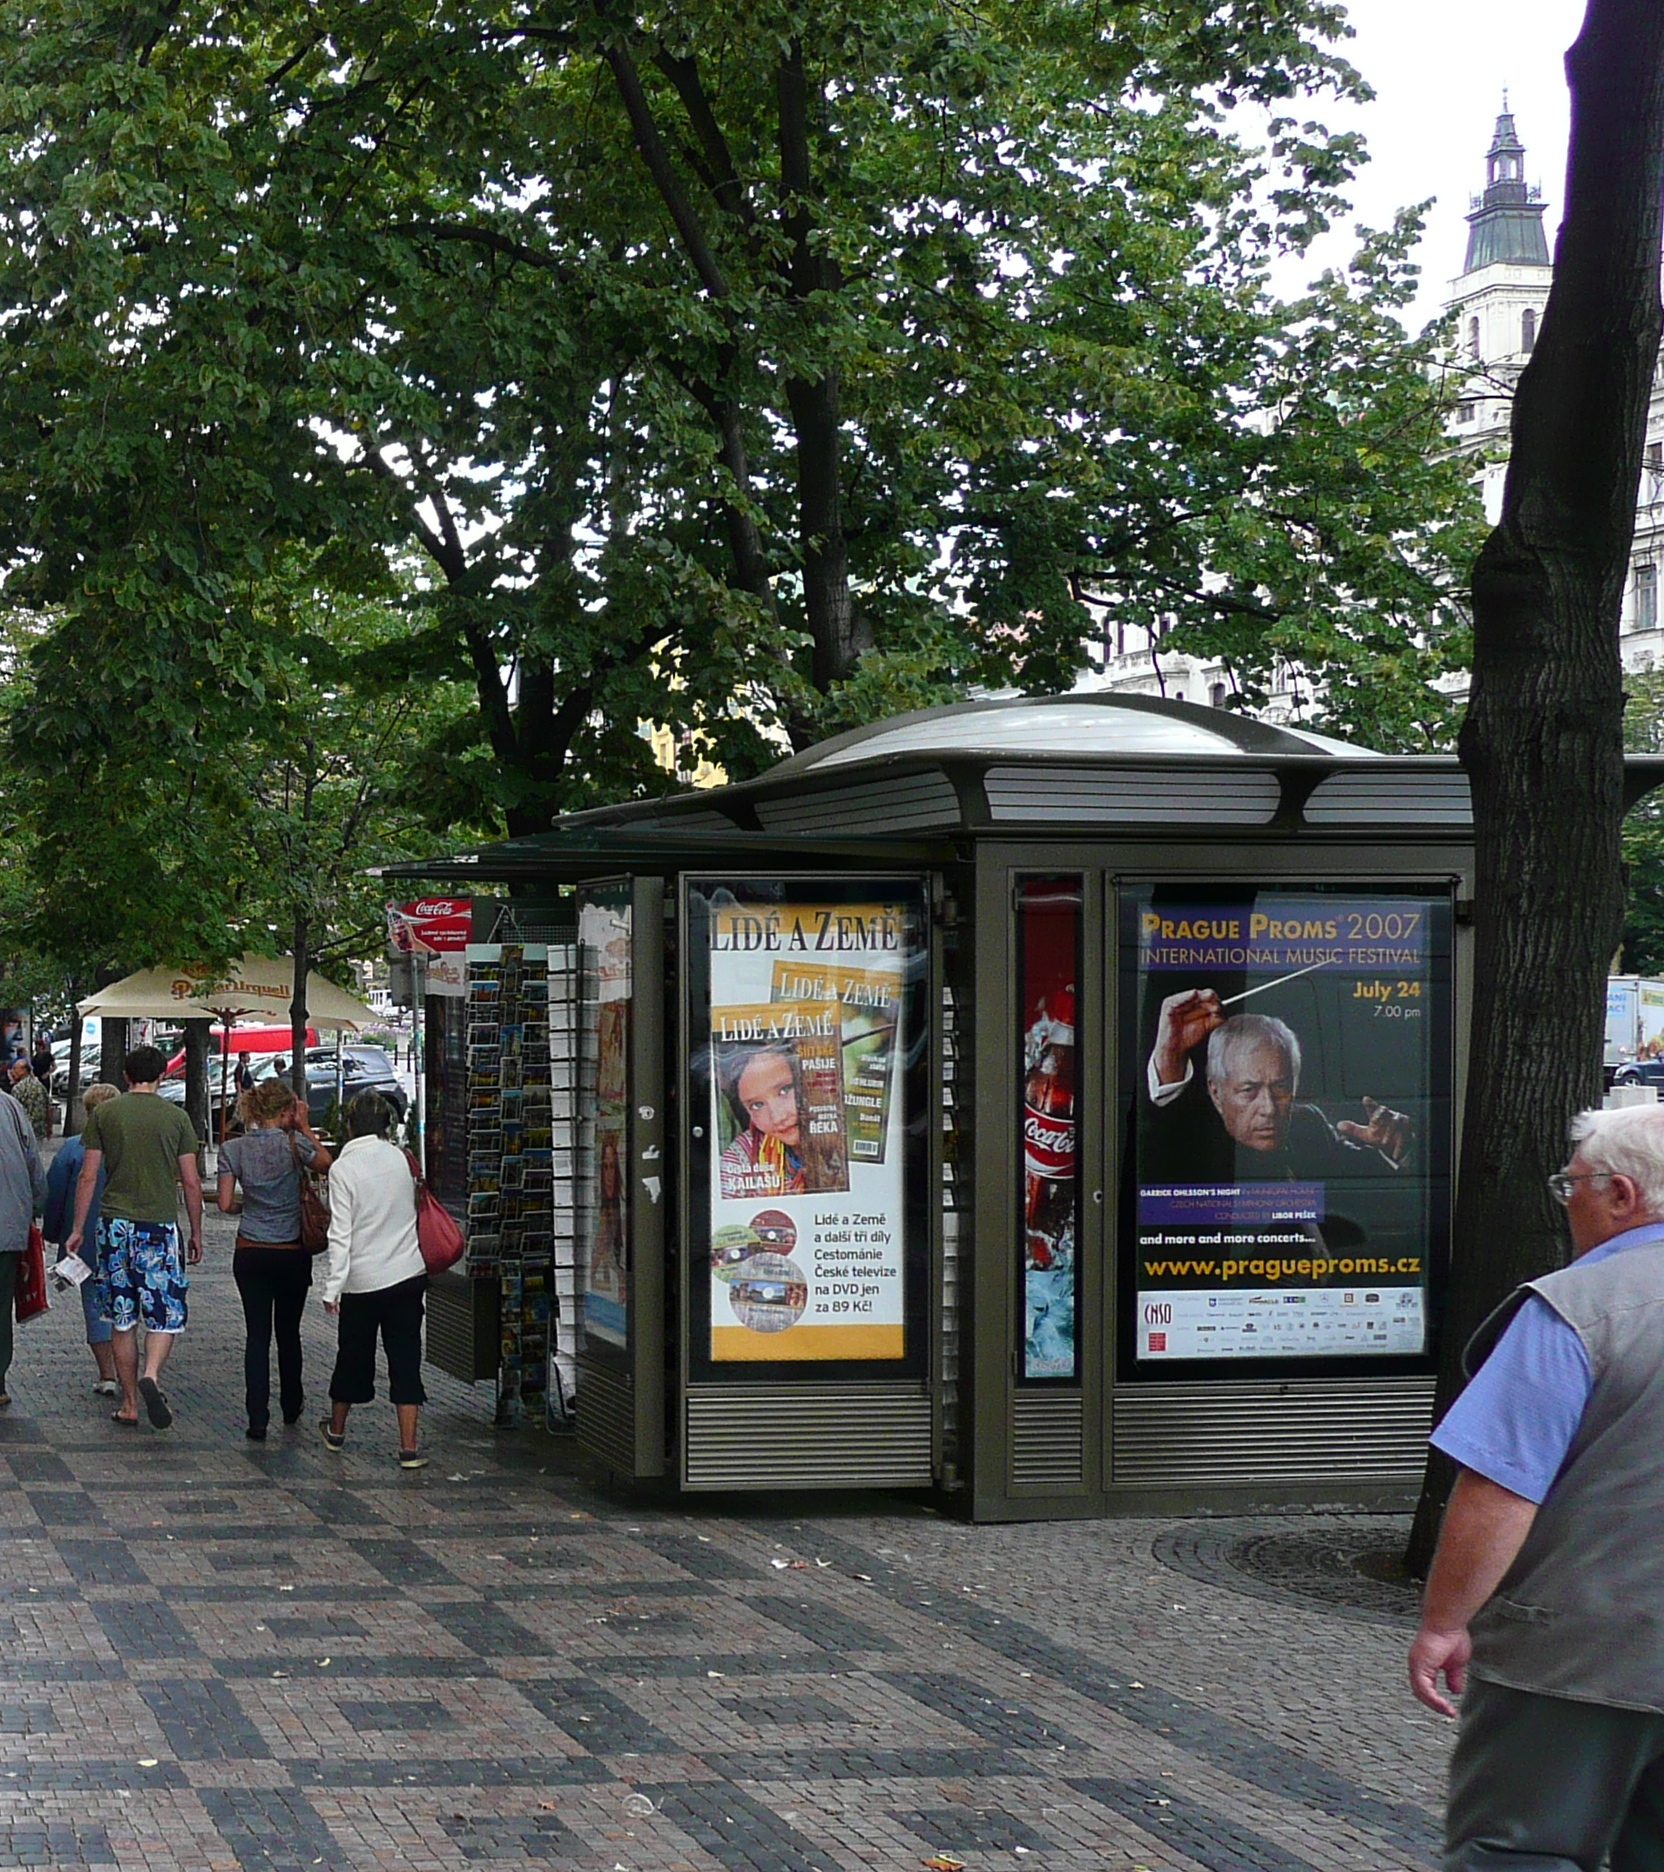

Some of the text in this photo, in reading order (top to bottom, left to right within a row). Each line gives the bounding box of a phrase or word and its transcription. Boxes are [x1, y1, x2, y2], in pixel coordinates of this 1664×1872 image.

[416, 902, 453, 916] Coca-Cola
[710, 910, 782, 951] LIDÉ
[1141, 912, 1421, 940] PRAGUE PROMS 2007
[1140, 947, 1421, 965] INTERNATIONAL MUSIC FESTIVAL
[1352, 980, 1421, 1003] July 24
[1404, 1007, 1421, 1020] pm
[802, 1057, 836, 1070] PAŠIJE
[809, 1120, 838, 1134] ŘEKA
[1216, 1188, 1241, 1196] NIGHT
[814, 1213, 887, 1226] Lidé a Země
[814, 1234, 821, 1243] a
[824, 1230, 853, 1243] další
[870, 1230, 892, 1246] díly
[1139, 1233, 1162, 1245] and
[1164, 1235, 1196, 1245] more
[1198, 1232, 1222, 1244] and
[1223, 1235, 1255, 1244] more
[814, 1247, 883, 1261] Cestománie
[814, 1264, 897, 1278] České televize
[1143, 1257, 1421, 1281] www.pragueproms.cz
[815, 1283, 880, 1297] na DVD jen
[815, 1303, 830, 1313] za
[832, 1301, 850, 1313] 89
[1144, 1303, 1172, 1325] CNSO
